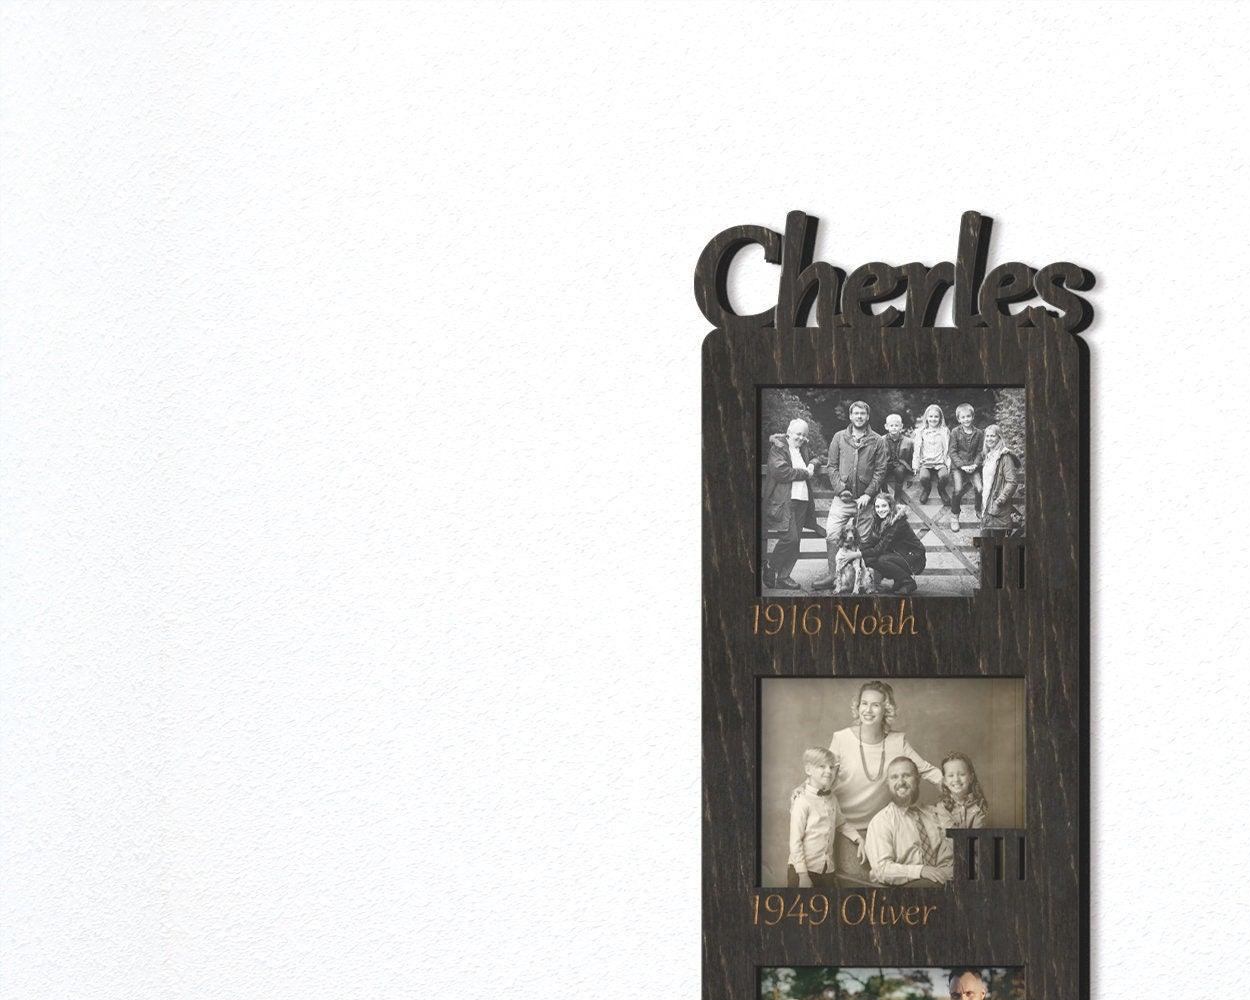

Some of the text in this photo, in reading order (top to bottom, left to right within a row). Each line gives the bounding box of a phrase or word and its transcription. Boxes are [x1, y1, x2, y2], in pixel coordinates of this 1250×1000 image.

[694, 210, 1096, 333] Cherles
[752, 599, 919, 636] 1916 Noah
[751, 889, 937, 926] 1949 Oliver
